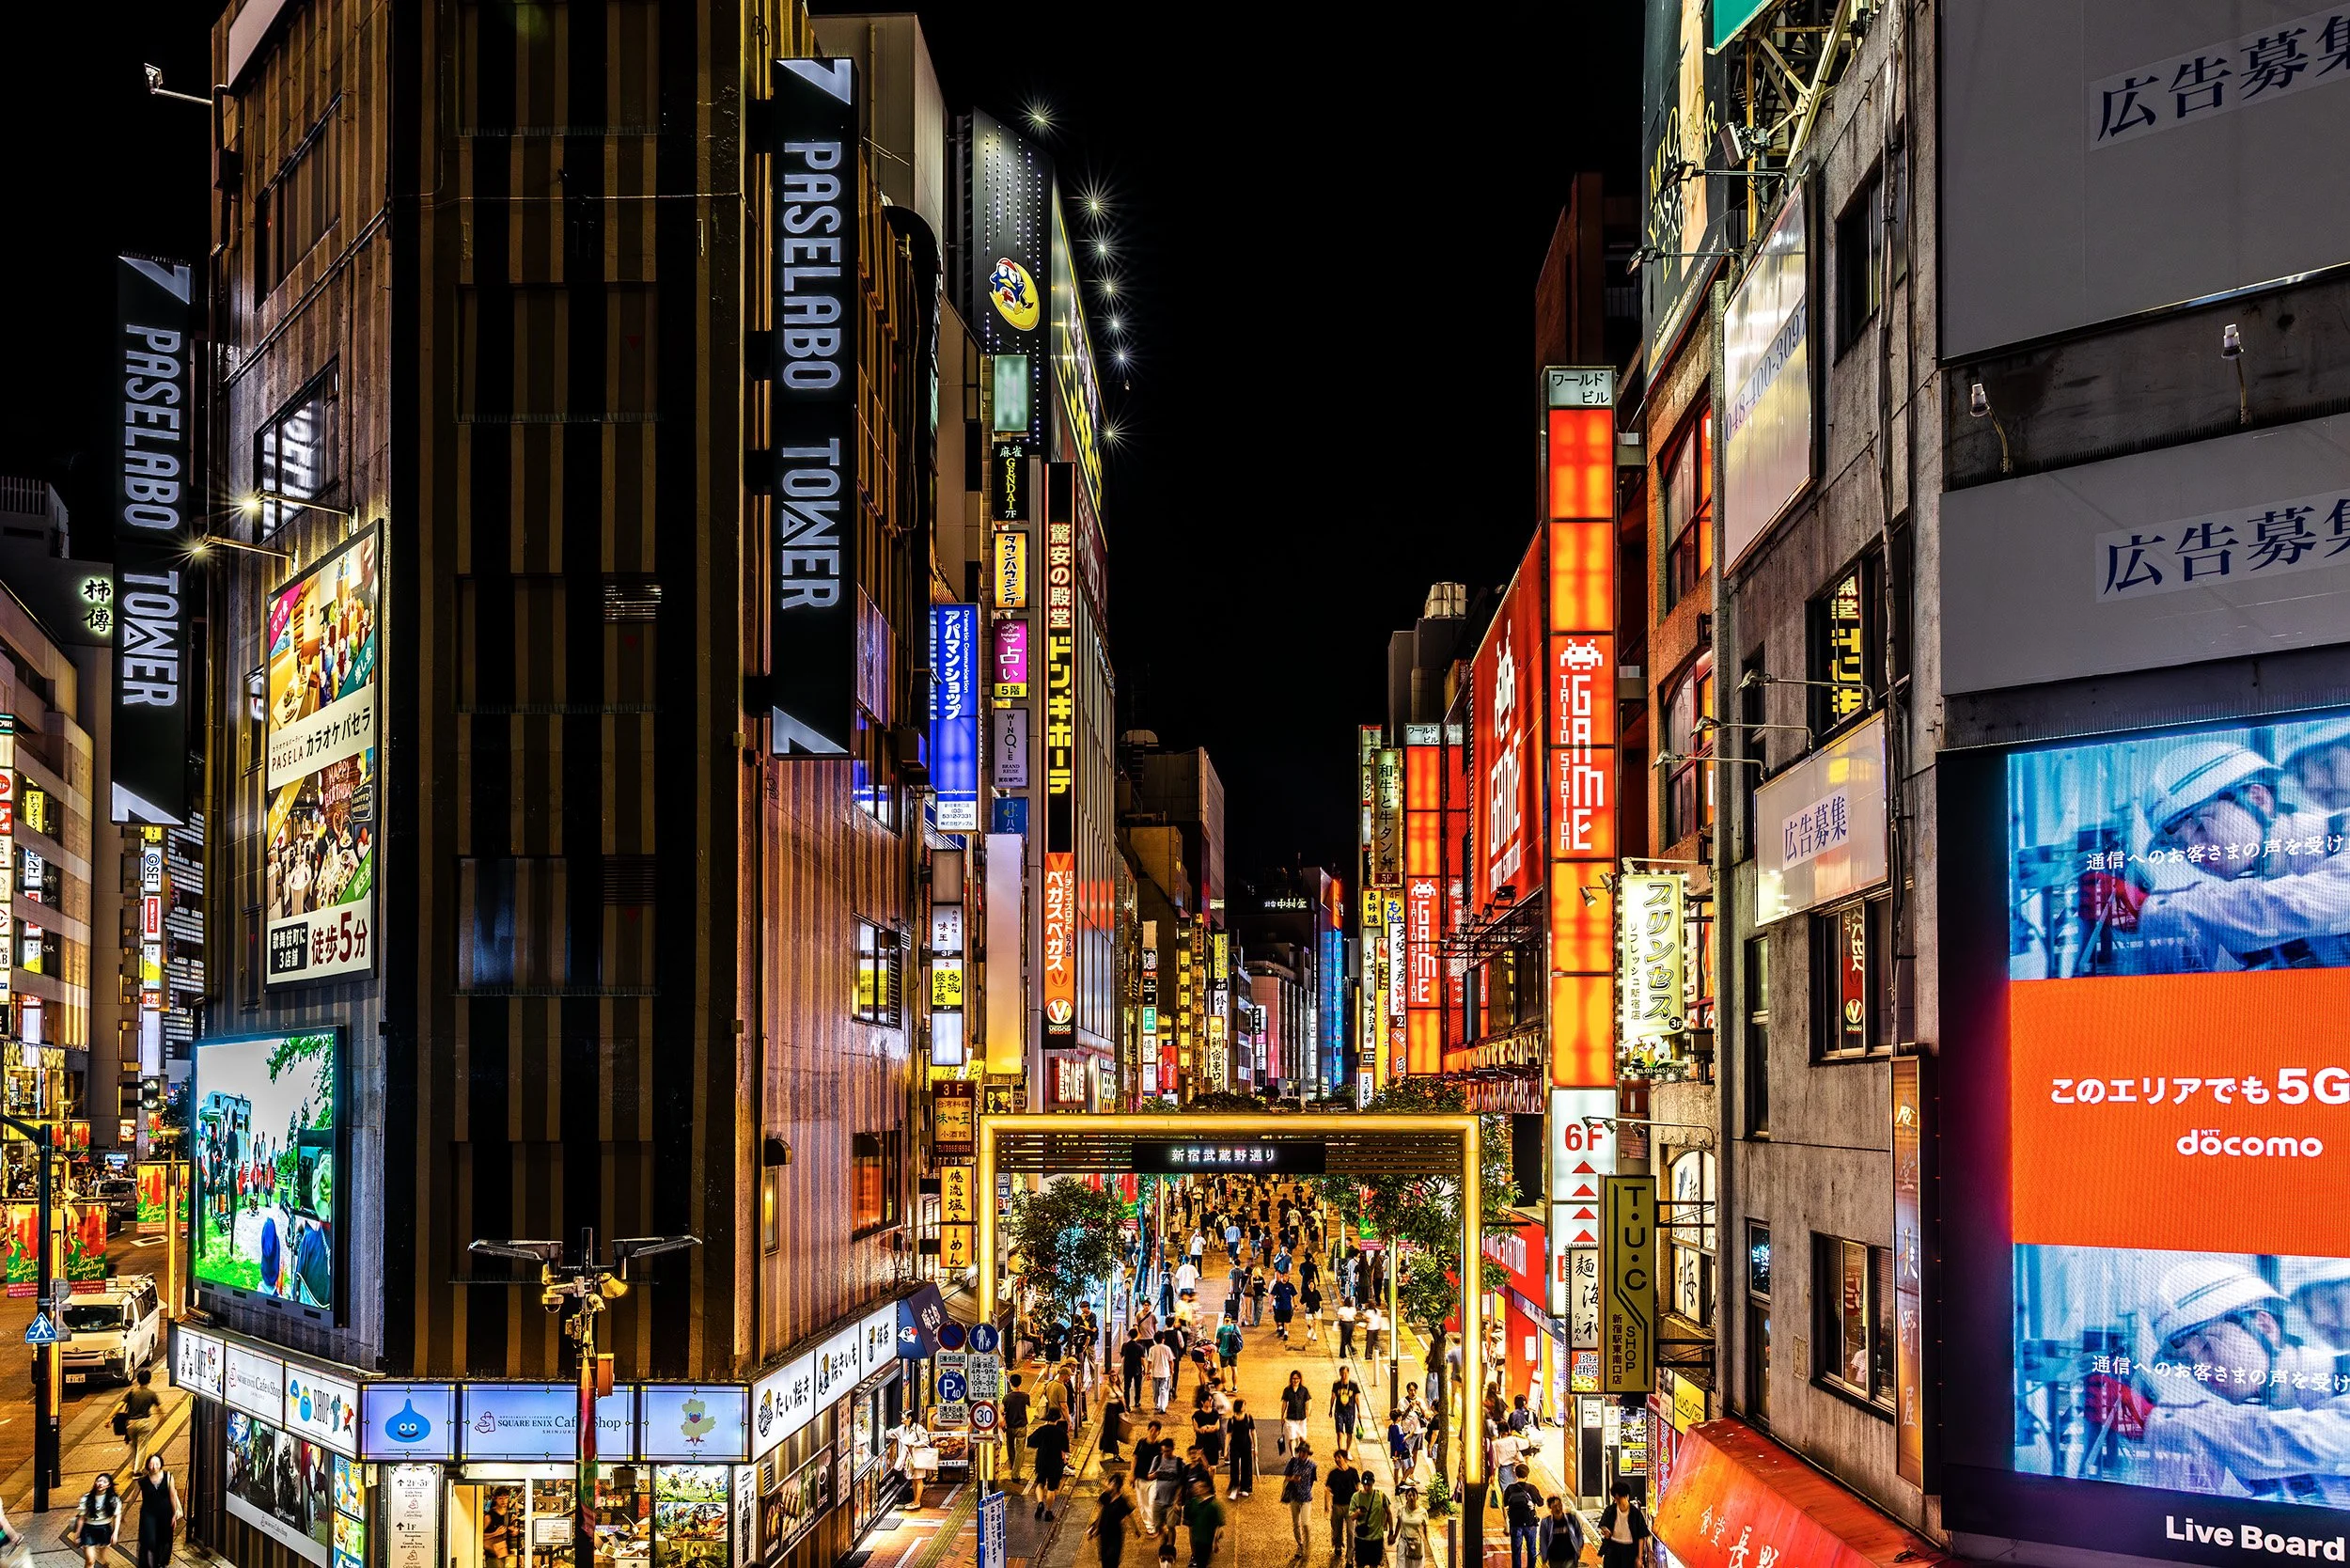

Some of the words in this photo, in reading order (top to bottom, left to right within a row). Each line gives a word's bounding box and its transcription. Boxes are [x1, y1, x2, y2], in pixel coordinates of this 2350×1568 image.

[783, 141, 841, 389] PASELABO
[1553, 373, 1605, 386] ワールド
[1582, 391, 1609, 404] ビル
[124, 324, 180, 530] PASELABO
[1000, 446, 1023, 457] 麻雀
[1006, 459, 1016, 510] GENDAI
[782, 437, 840, 609] TOWER
[1003, 535, 1022, 605] タウンハウジング
[1049, 523, 1072, 629] 驚安の殿堂
[123, 571, 179, 708] TOWER
[944, 610, 962, 720] アパマンショップ
[999, 646, 1023, 681] 占い
[1001, 685, 1020, 696] 5階
[1560, 675, 1569, 744] TAITO
[306, 705, 371, 758] カラオケパセラ
[1407, 727, 1436, 735] ワールド
[272, 745, 304, 772] PASELA
[1573, 675, 1604, 850] GAME
[1560, 753, 1570, 850] STATION
[1785, 794, 1847, 863] 広告募集
[1382, 874, 1393, 883] 5F
[272, 927, 306, 950] 歌舞伎町に
[311, 911, 368, 966] 徒歩5分
[937, 921, 948, 942] 味王
[1047, 870, 1065, 971] ベガスベガス
[278, 949, 298, 970] 3店舗
[1418, 901, 1436, 1002] GAME
[1642, 882, 1676, 1021] プリンセス
[1397, 1016, 1404, 1027] 2
[1670, 1018, 1683, 1028] 3F
[937, 1100, 970, 1108] 台湾料理
[1171, 1149, 1275, 1162] 新宿武蔵野通り
[1565, 1122, 1603, 1152] 6F
[2176, 1129, 2324, 1157] docomo
[195, 1348, 207, 1379] CAFE
[1612, 1313, 1622, 1385] 新宿駅東南口店
[1625, 1325, 1636, 1372] SHOP
[313, 1388, 329, 1425] SHOP
[776, 1373, 809, 1419] たい焼き
[944, 1379, 955, 1398] P
[497, 1419, 529, 1428] SQUARE
[555, 1415, 577, 1428] Caf
[594, 1416, 621, 1431] Shop
[976, 1409, 992, 1422] 30
[2165, 1514, 2234, 1546] Live
[2240, 1528, 2346, 1561] Board
